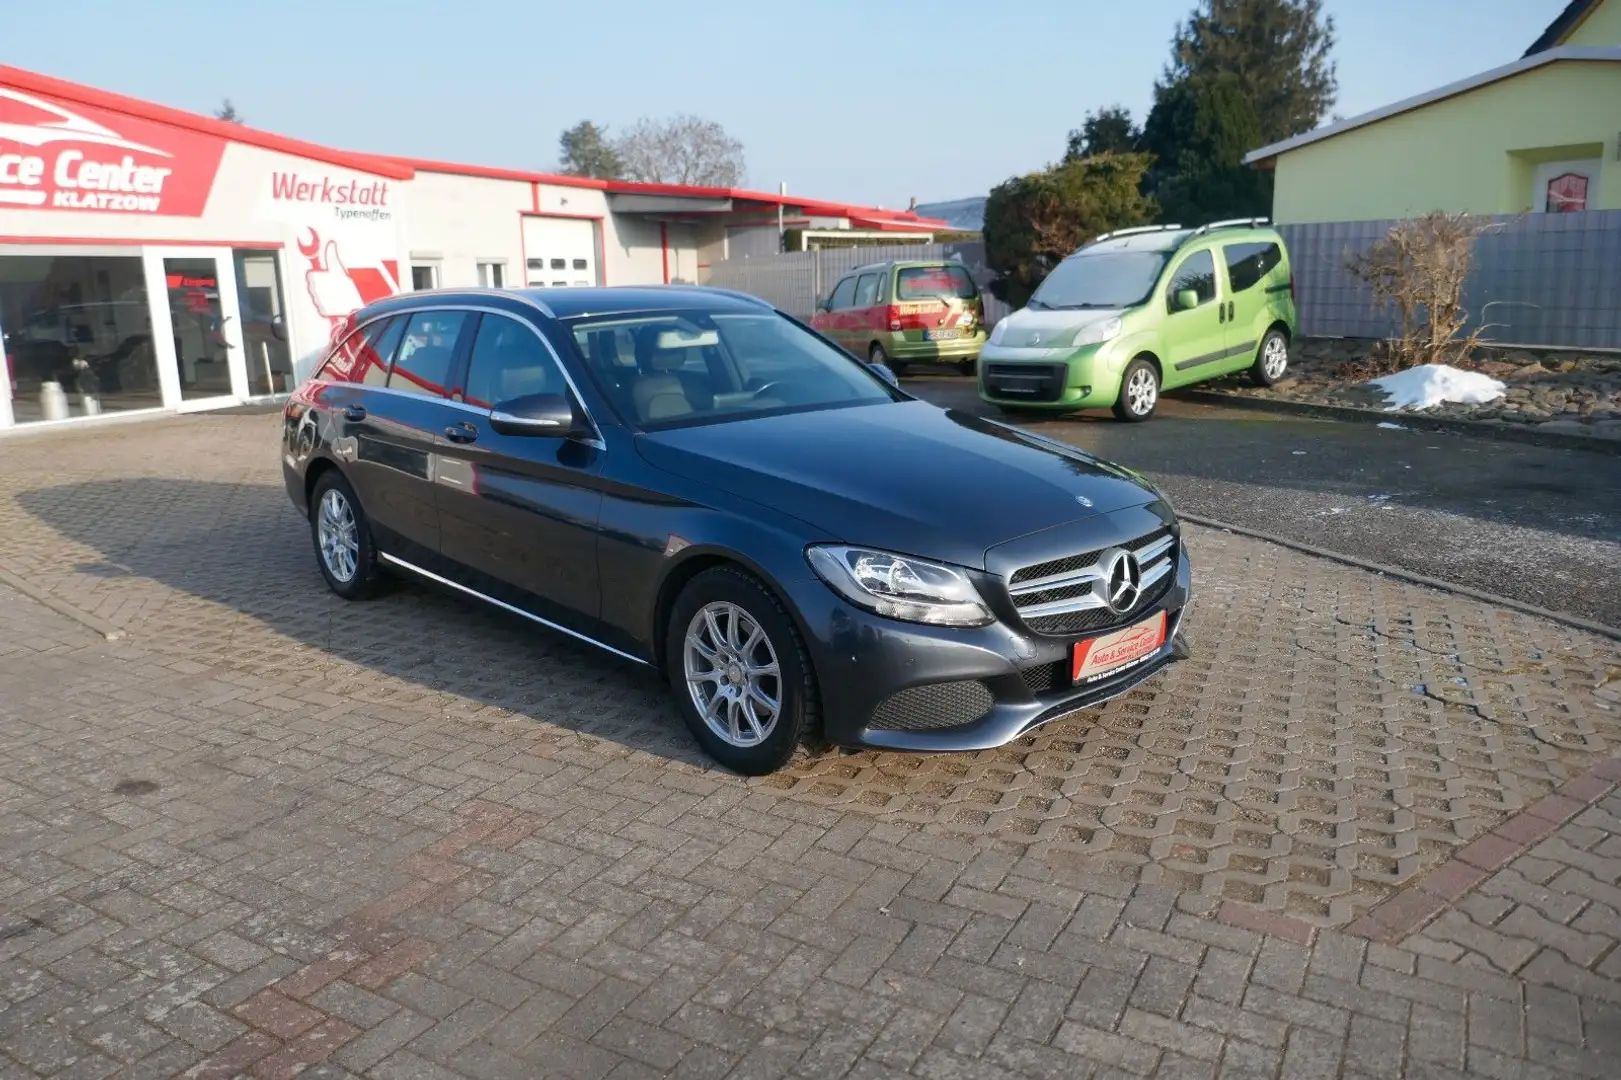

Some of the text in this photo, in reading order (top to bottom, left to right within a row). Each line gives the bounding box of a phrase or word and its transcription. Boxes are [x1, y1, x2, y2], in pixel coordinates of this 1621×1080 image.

[0, 148, 173, 194] ce Center
[271, 171, 390, 206] Werkstatt
[52, 191, 161, 212] KLATZOW
[333, 206, 392, 221] Typenoffen
[1092, 654, 1108, 664] Auto
[1109, 650, 1115, 659] &
[1116, 642, 1139, 657] Service
